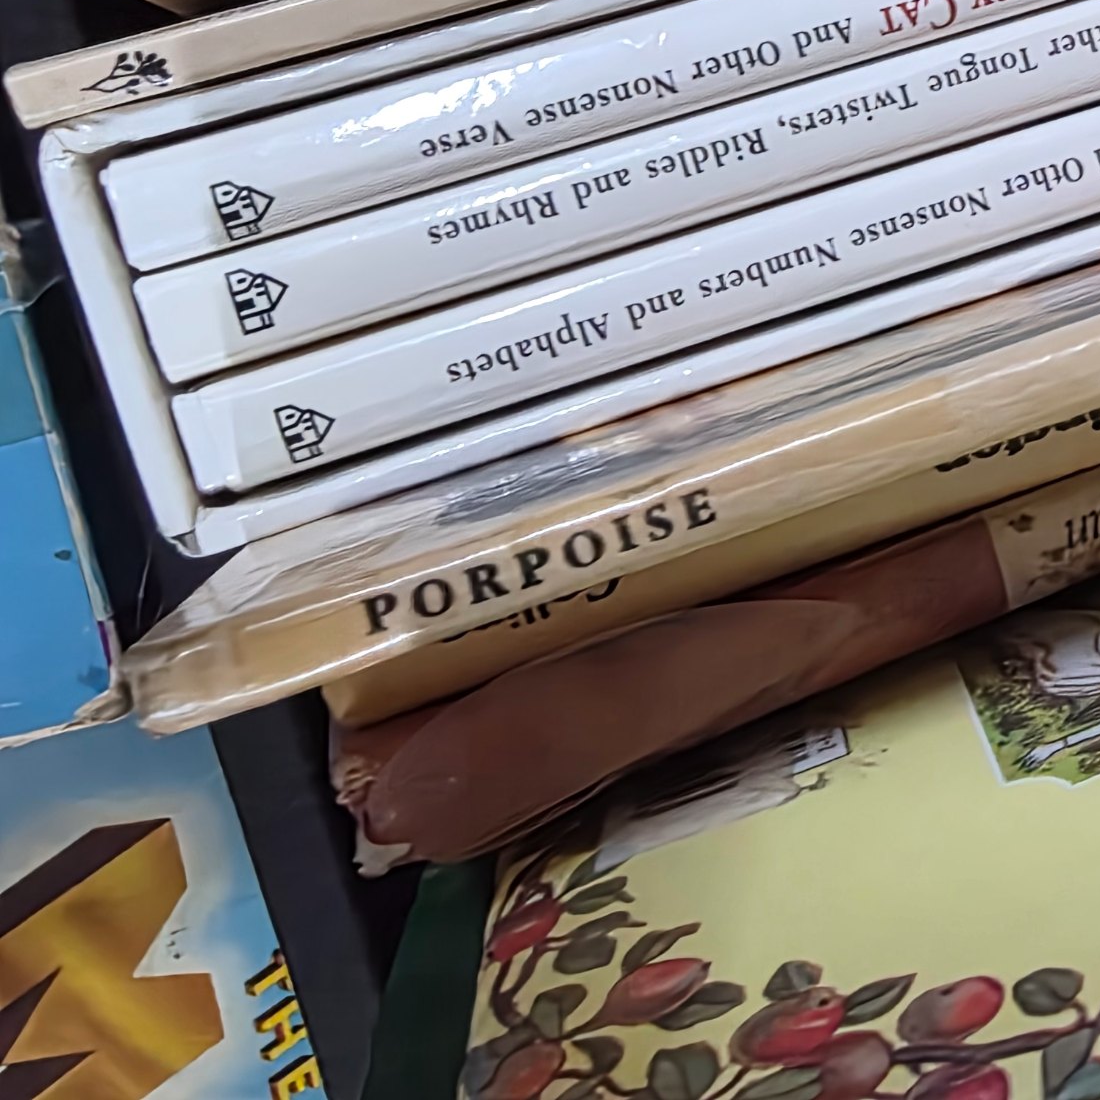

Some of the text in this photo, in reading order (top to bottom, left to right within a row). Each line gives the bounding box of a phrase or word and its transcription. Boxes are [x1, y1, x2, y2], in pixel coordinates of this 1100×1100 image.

[691, 39, 782, 83] Other
[792, 16, 853, 53] And
[525, 67, 681, 128] Nonsense
[928, 44, 1038, 98] Tongue
[776, 80, 920, 138] Twisters,
[420, 117, 514, 162] Verse
[645, 126, 769, 180] Riddles
[572, 168, 632, 214] and
[1001, 156, 1086, 198] Other
[426, 188, 560, 247] Rhymes
[850, 186, 992, 248] Nonsense
[697, 237, 842, 298] Numbers
[624, 288, 686, 330] and
[446, 311, 609, 386] Alphabets
[361, 486, 719, 636] PORPOISE
